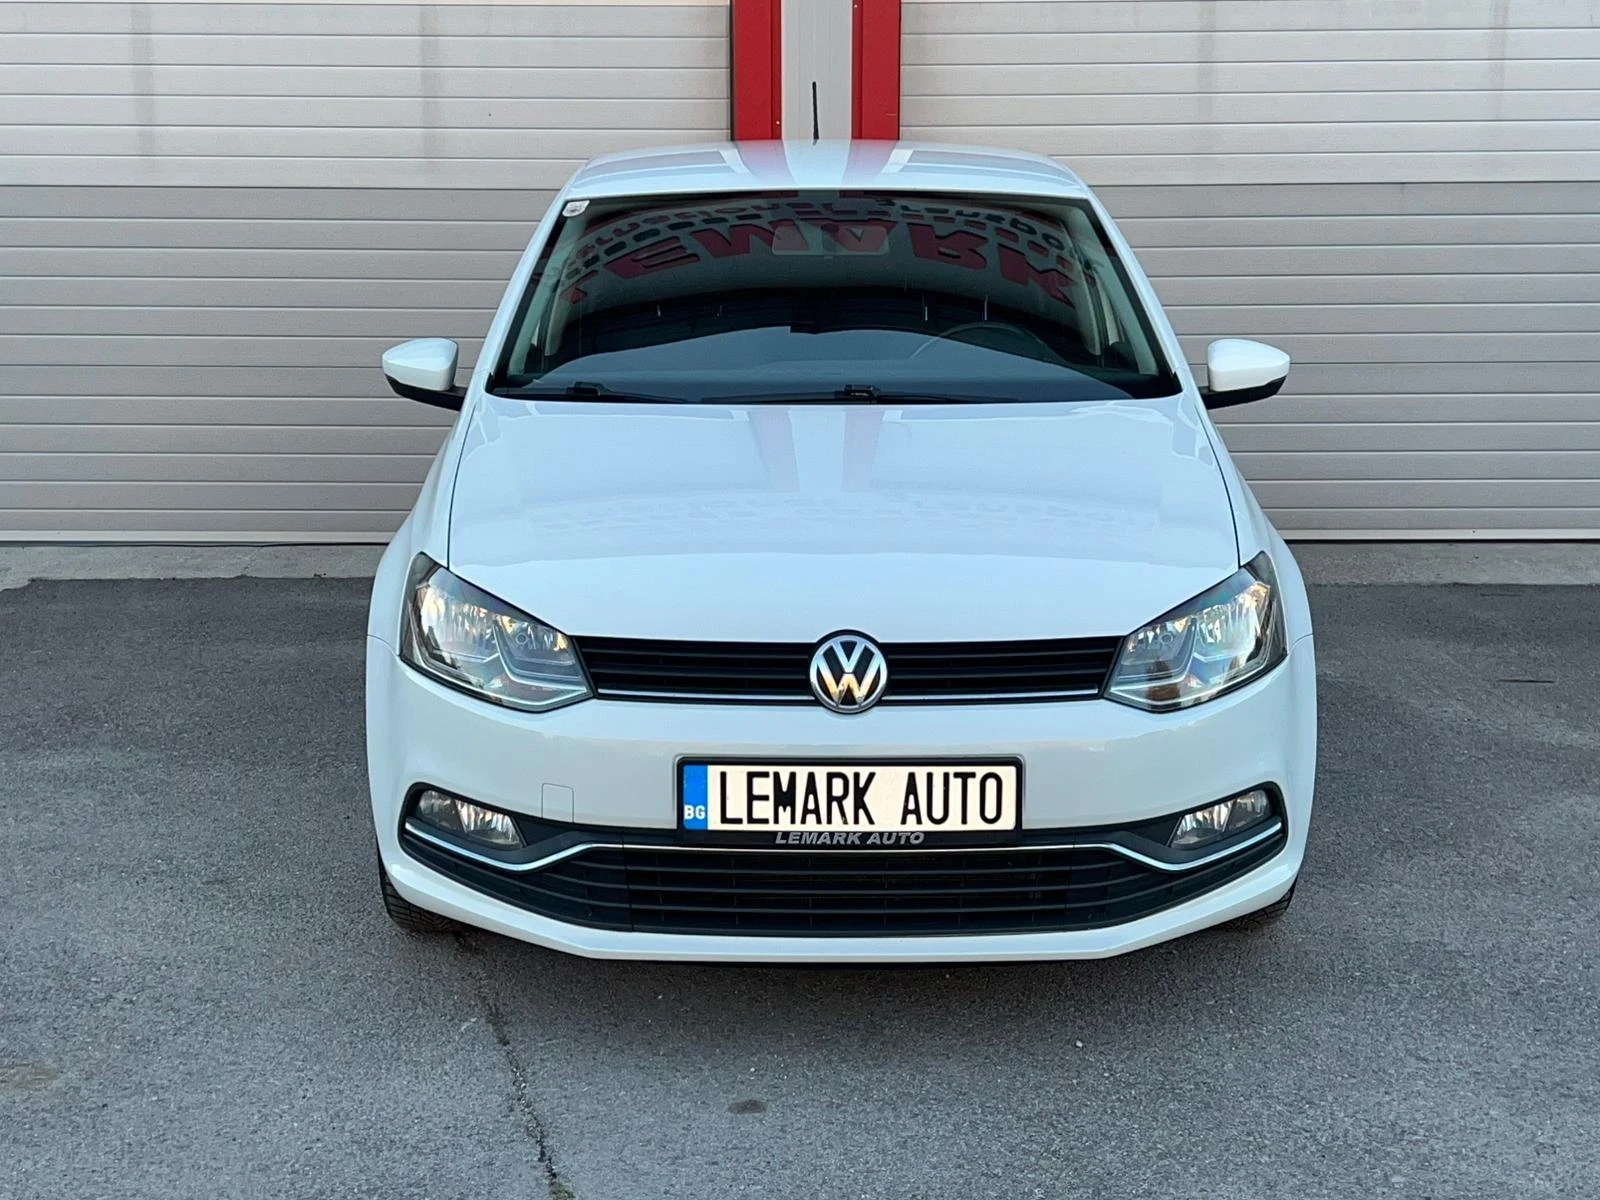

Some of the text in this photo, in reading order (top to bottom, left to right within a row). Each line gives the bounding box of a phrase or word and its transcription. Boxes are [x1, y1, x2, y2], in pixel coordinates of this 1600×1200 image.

[812, 635, 885, 708] VW
[683, 804, 706, 820] BG
[719, 771, 1003, 826] LEMARK AUTO
[774, 831, 925, 846] LEMARK AUTO
